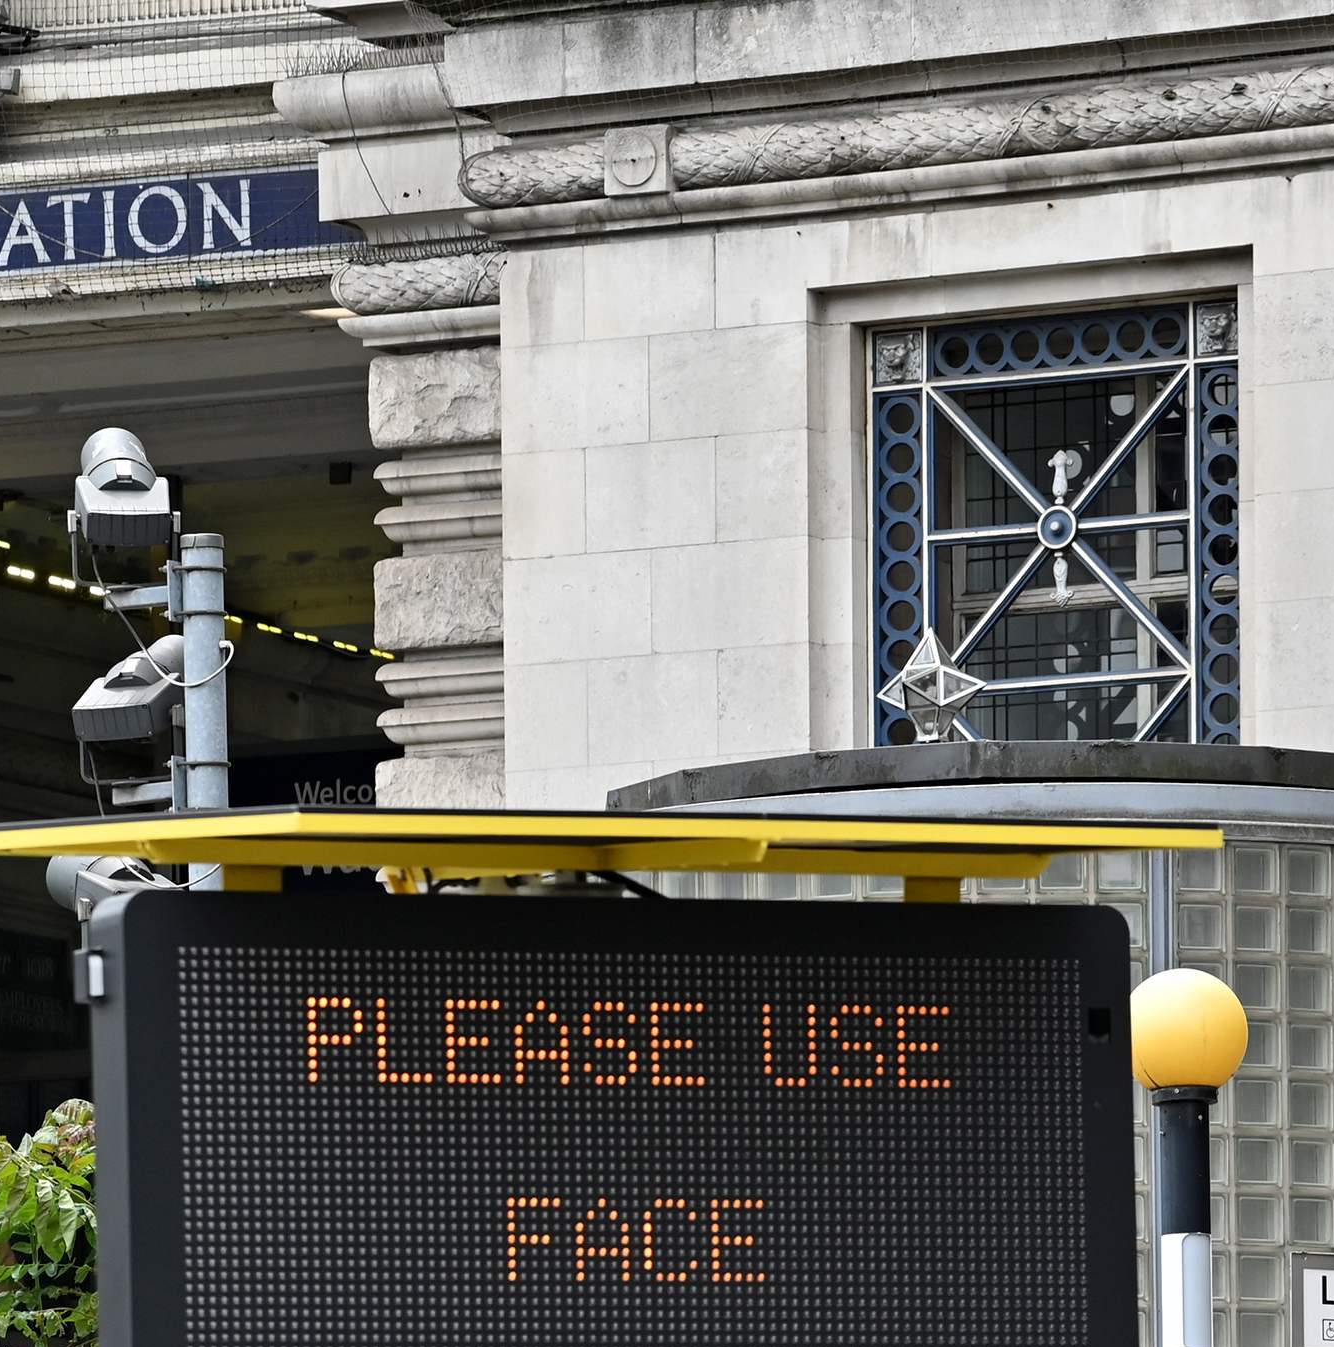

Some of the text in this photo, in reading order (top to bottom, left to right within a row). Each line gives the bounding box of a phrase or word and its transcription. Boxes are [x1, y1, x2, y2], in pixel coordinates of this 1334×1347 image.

[294, 778, 374, 806] Welco
[308, 998, 951, 1088] PLEASE USE
[507, 1197, 765, 1282] FACE
